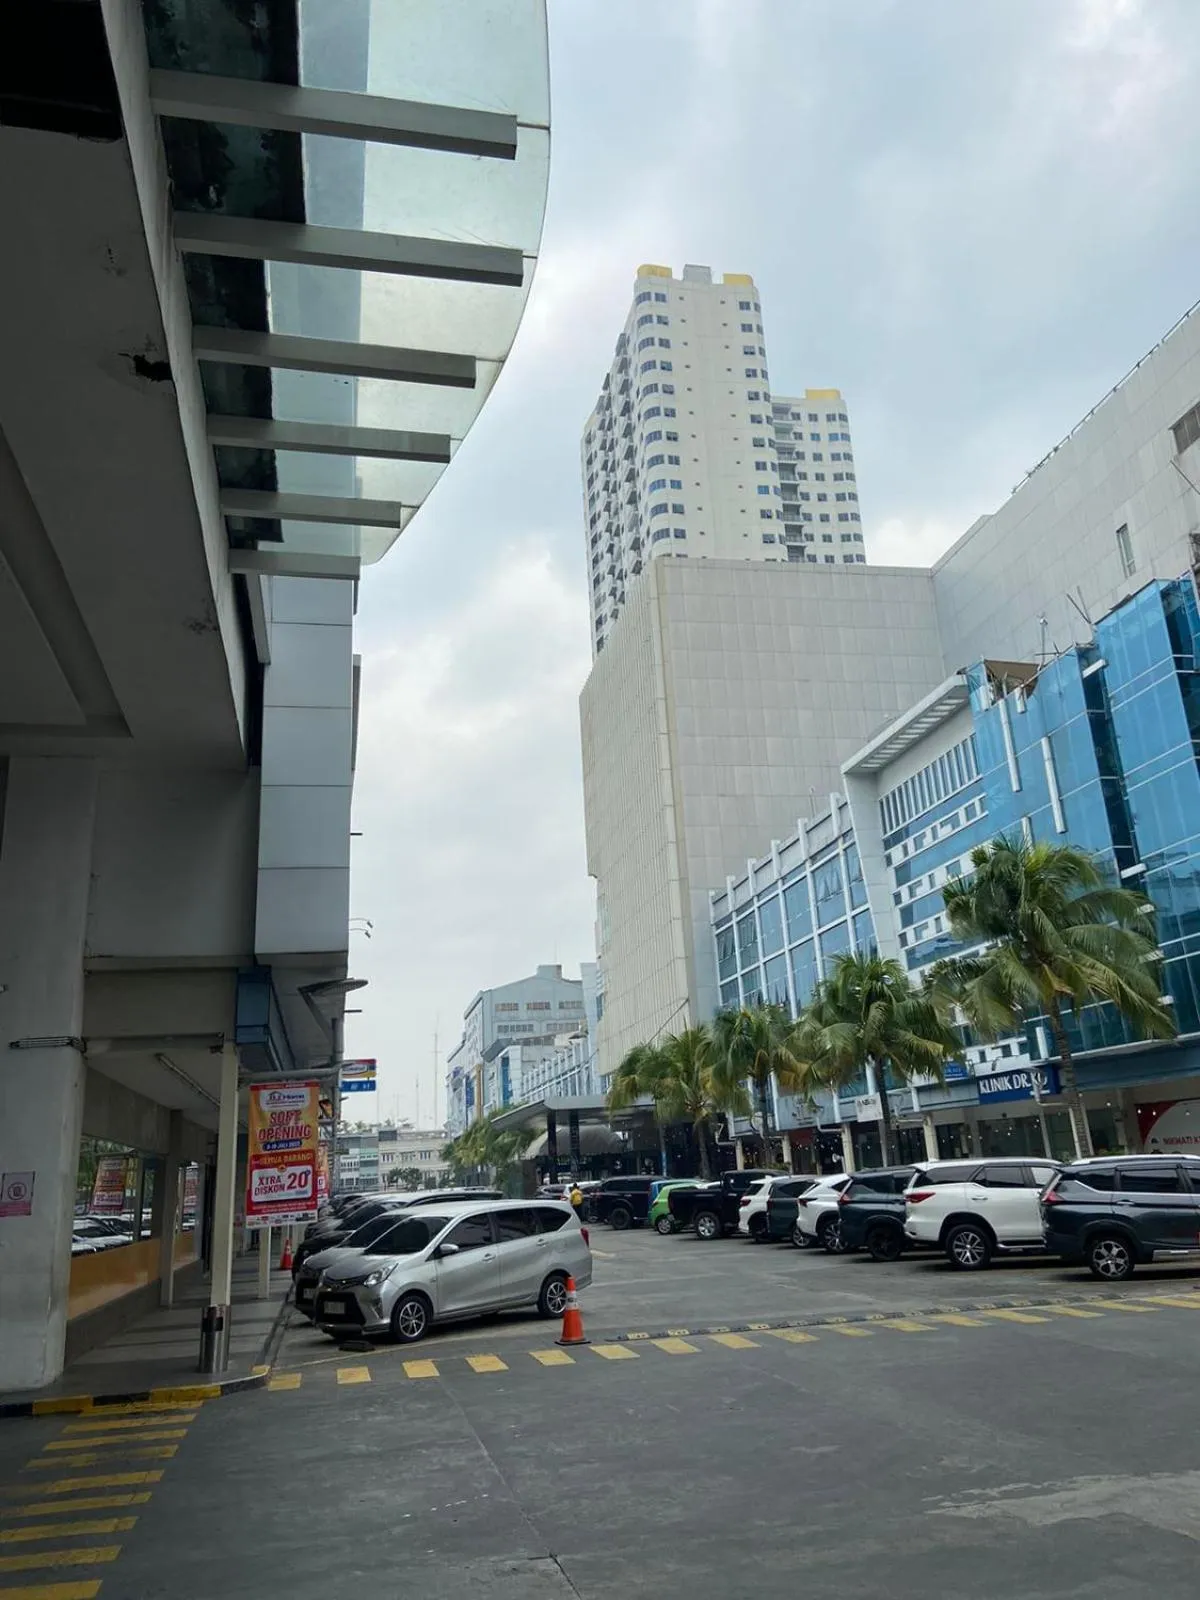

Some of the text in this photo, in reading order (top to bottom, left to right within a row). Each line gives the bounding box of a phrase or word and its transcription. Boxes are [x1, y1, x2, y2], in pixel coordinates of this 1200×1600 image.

[978, 1075, 1012, 1095] KLINIK
[270, 1110, 301, 1126] SOFT
[257, 1125, 312, 1142] OPENING
[258, 1175, 282, 1187] XTRA
[254, 1183, 286, 1196] DISKON
